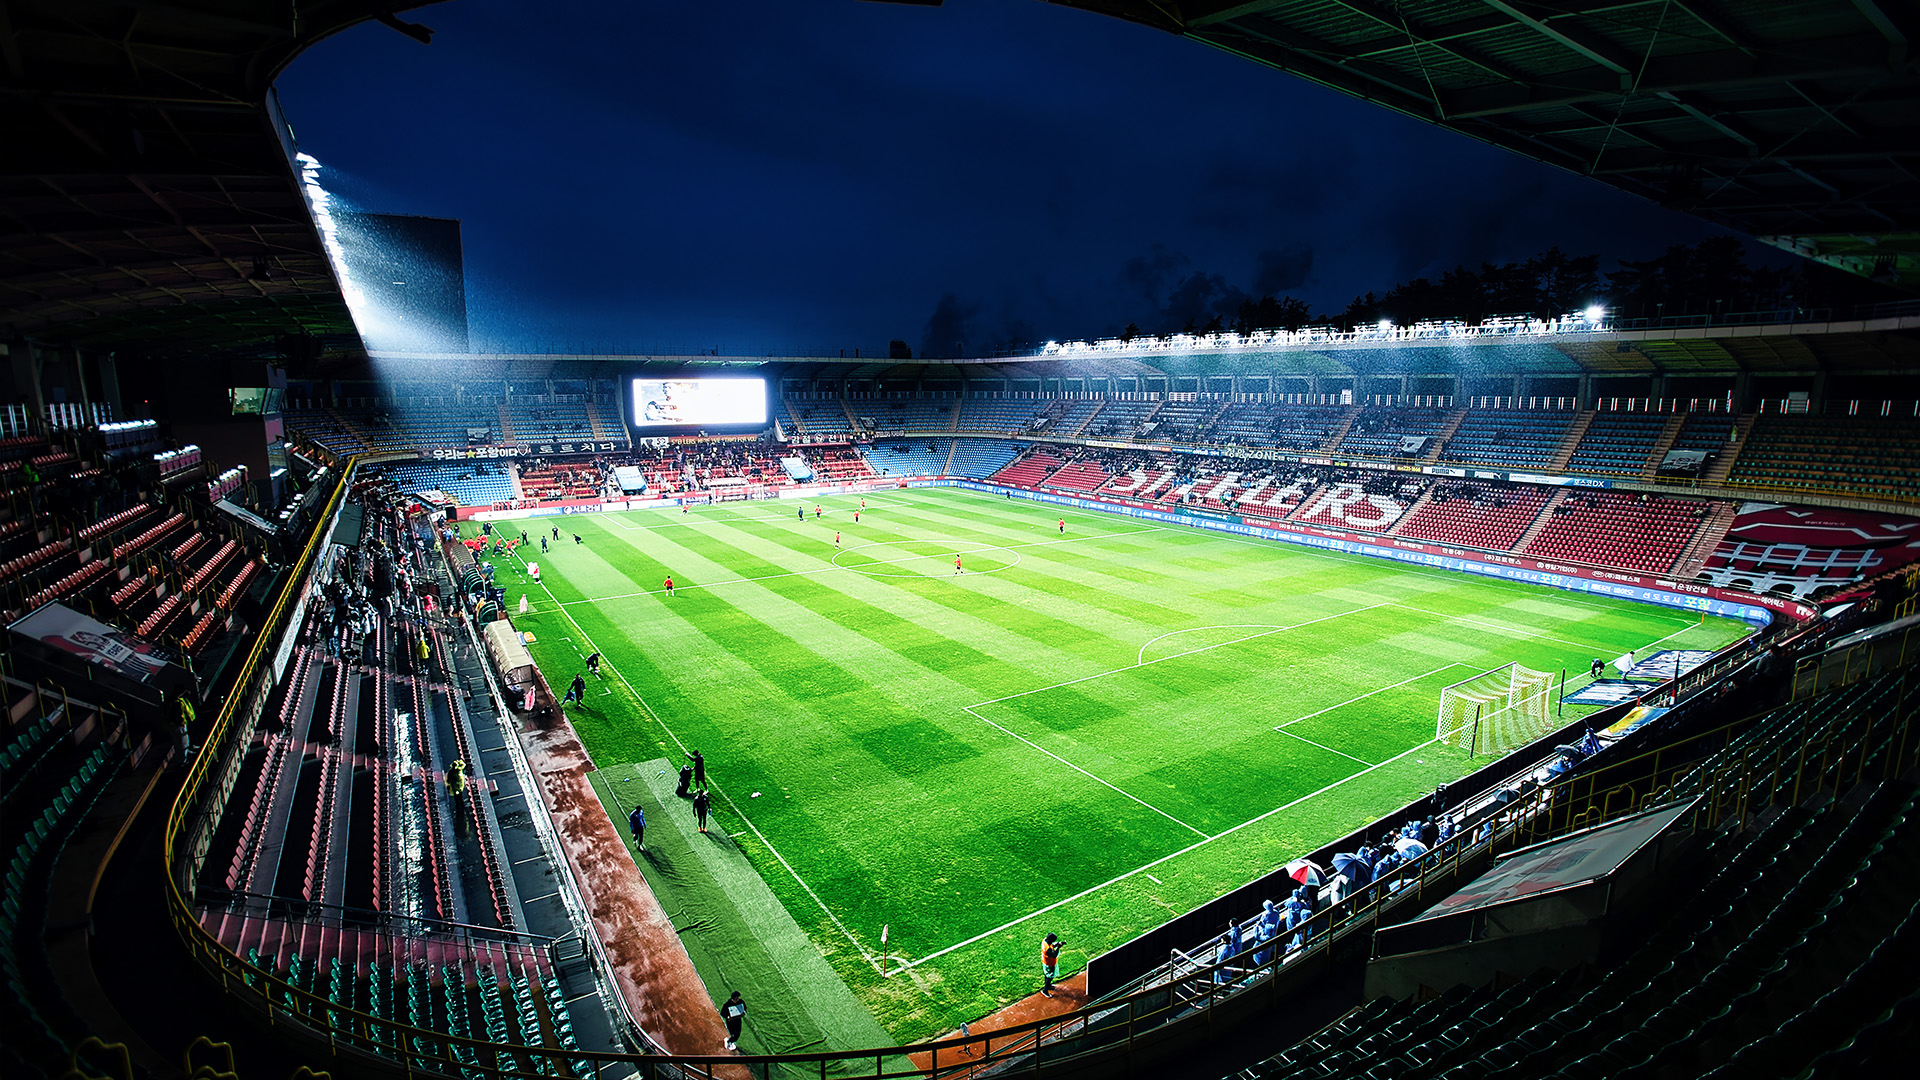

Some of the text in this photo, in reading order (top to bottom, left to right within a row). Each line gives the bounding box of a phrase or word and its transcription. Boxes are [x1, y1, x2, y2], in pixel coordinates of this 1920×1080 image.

[433, 447, 518, 460] 우리는 포항이다
[1249, 449, 1279, 460] ZONE
[1431, 467, 1450, 475] PUMA
[1573, 479, 1605, 488] 포스코DX
[1107, 465, 1422, 527] STEELERS
[1424, 554, 1443, 565] 포항
[1539, 573, 1562, 585] 포항
[1683, 596, 1712, 610] 포항
